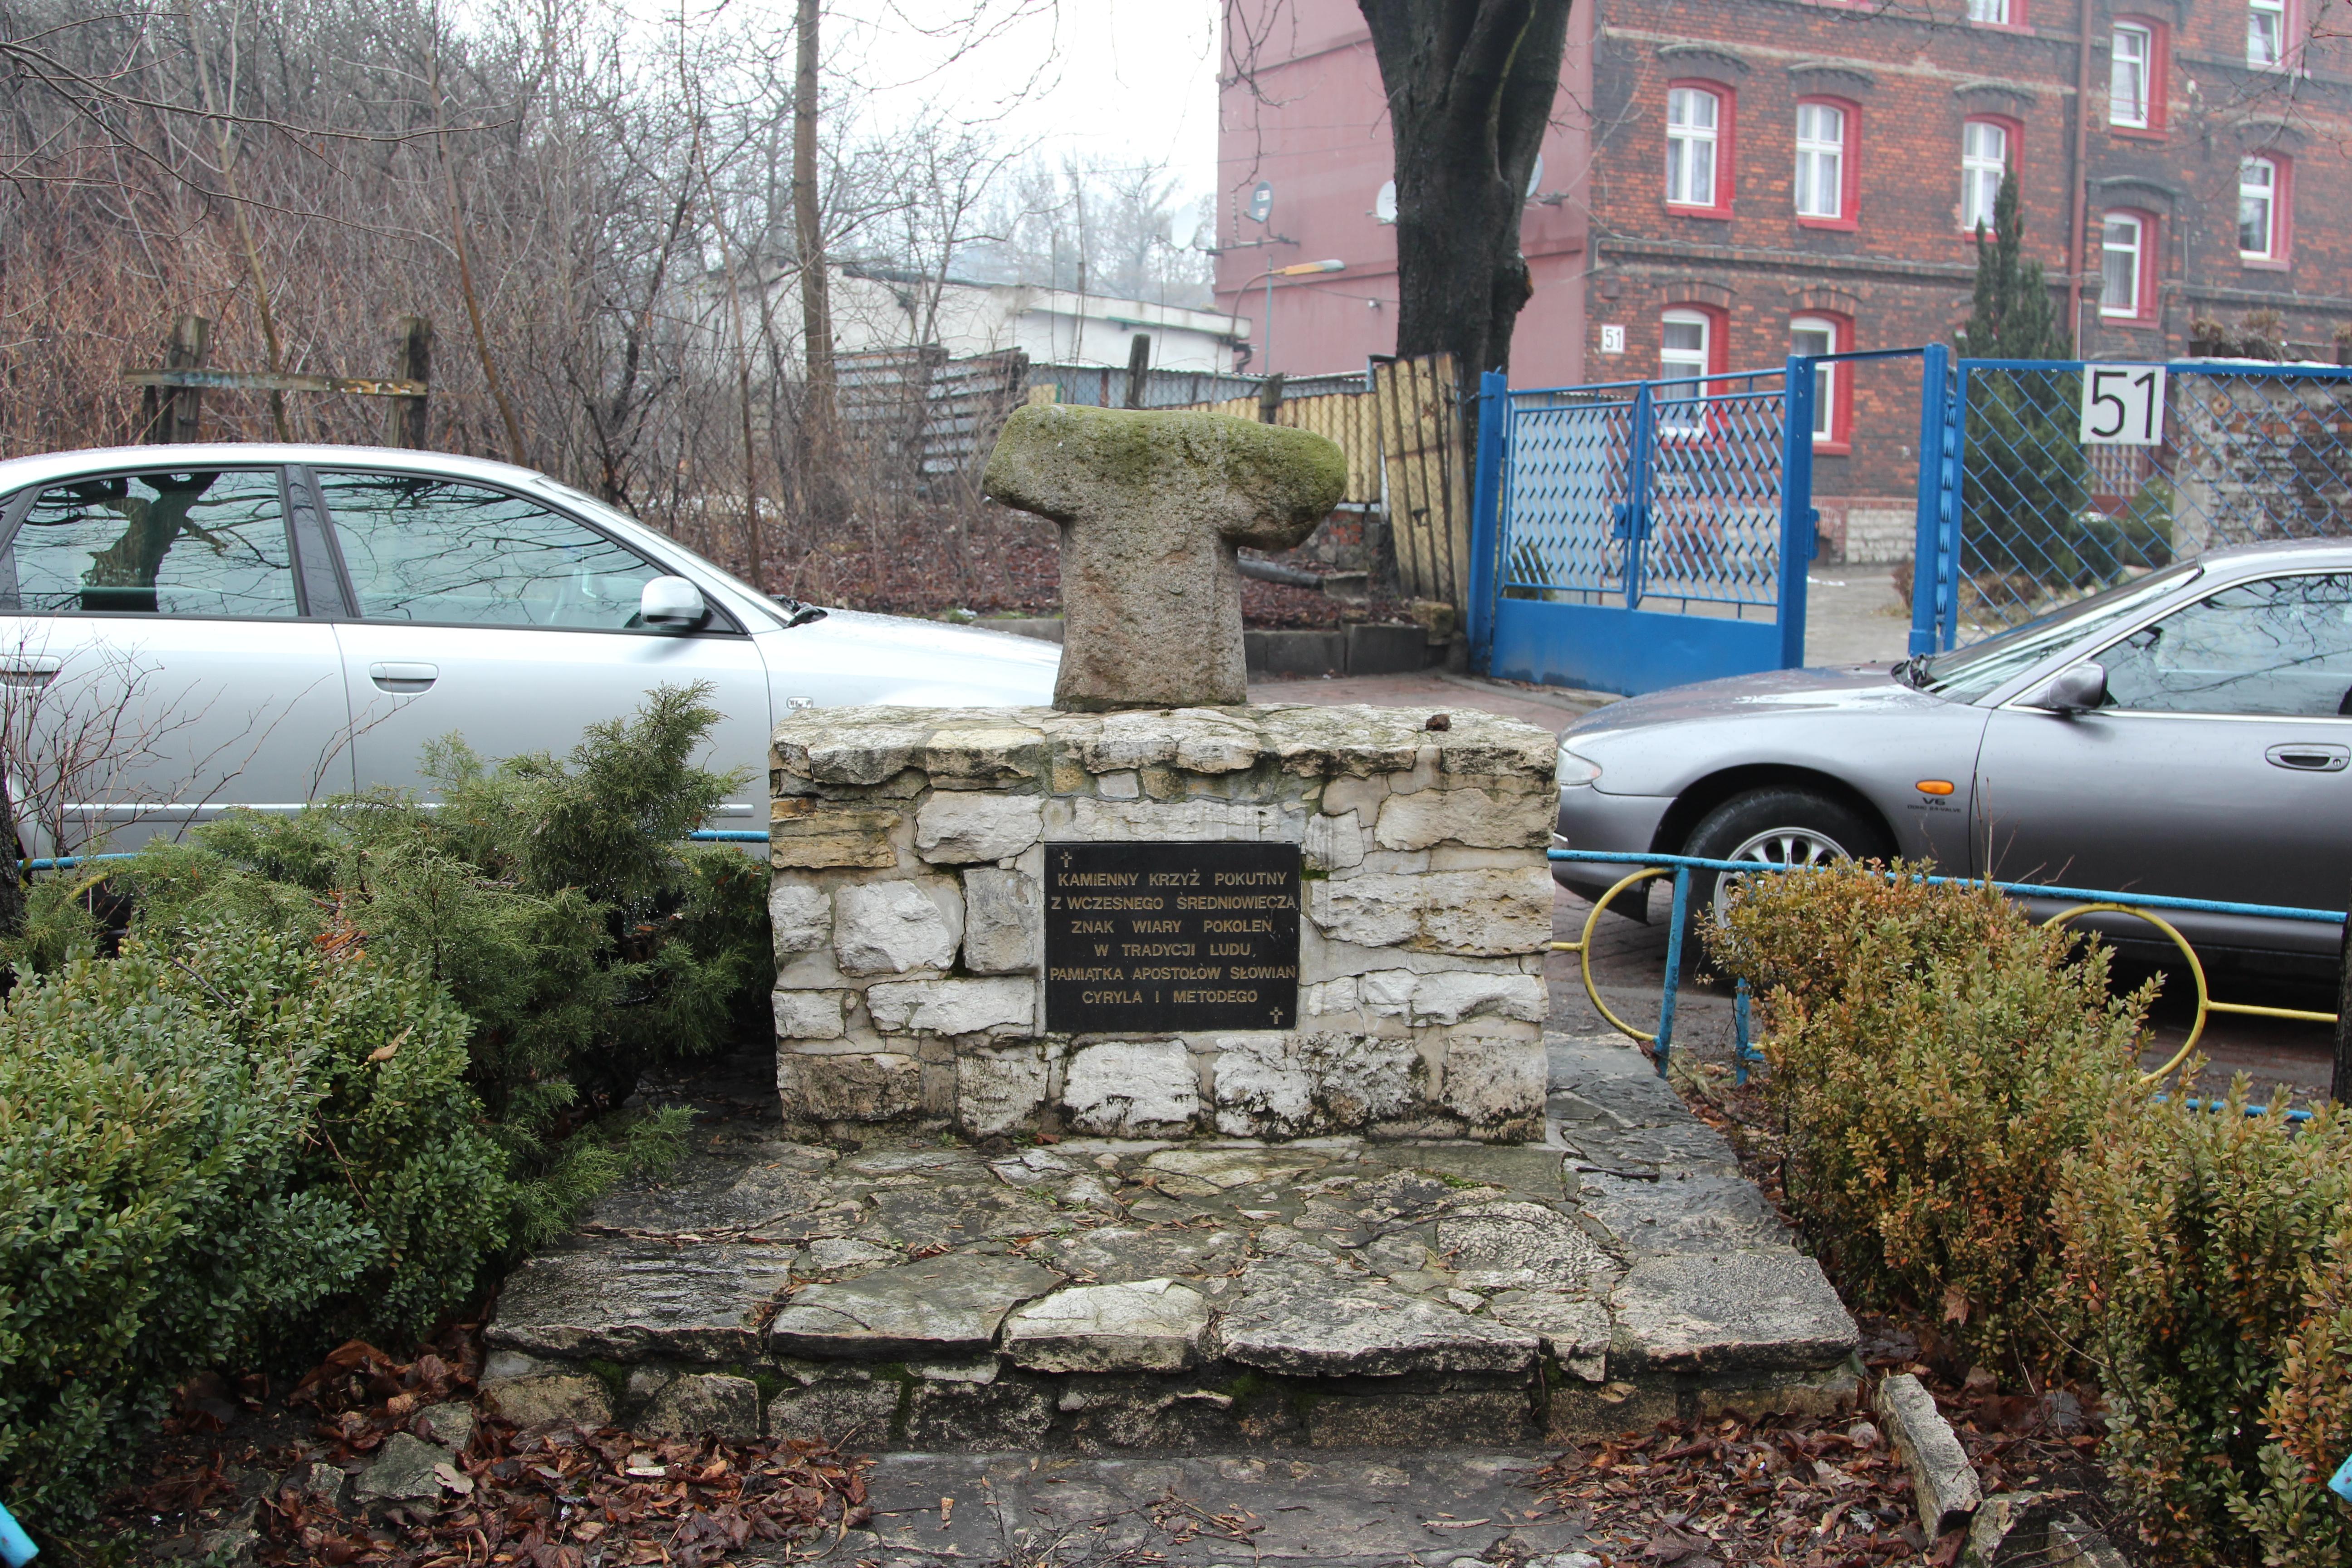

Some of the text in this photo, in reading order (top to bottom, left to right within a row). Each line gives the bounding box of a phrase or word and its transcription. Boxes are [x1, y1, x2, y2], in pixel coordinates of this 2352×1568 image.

[1606, 329, 1621, 348] 51
[2091, 371, 2155, 439] 51
[1923, 797, 1945, 805] V6
[1058, 868, 1288, 886] KAMIENNY KRZYŻ POKUTNY
[1051, 897, 1061, 909] Z
[1067, 897, 1164, 910] WCZESNEGO
[1072, 921, 1114, 933] ZNAK
[1132, 920, 1181, 933] WIARY
[1094, 945, 1109, 956] W
[1122, 944, 1196, 956] TRADYCJI
[1050, 963, 1296, 982] PAMIĄTKA APOSTOŁÓW SŁOWIAN
[1082, 990, 1258, 1004] CYRYLA I METODEGO
